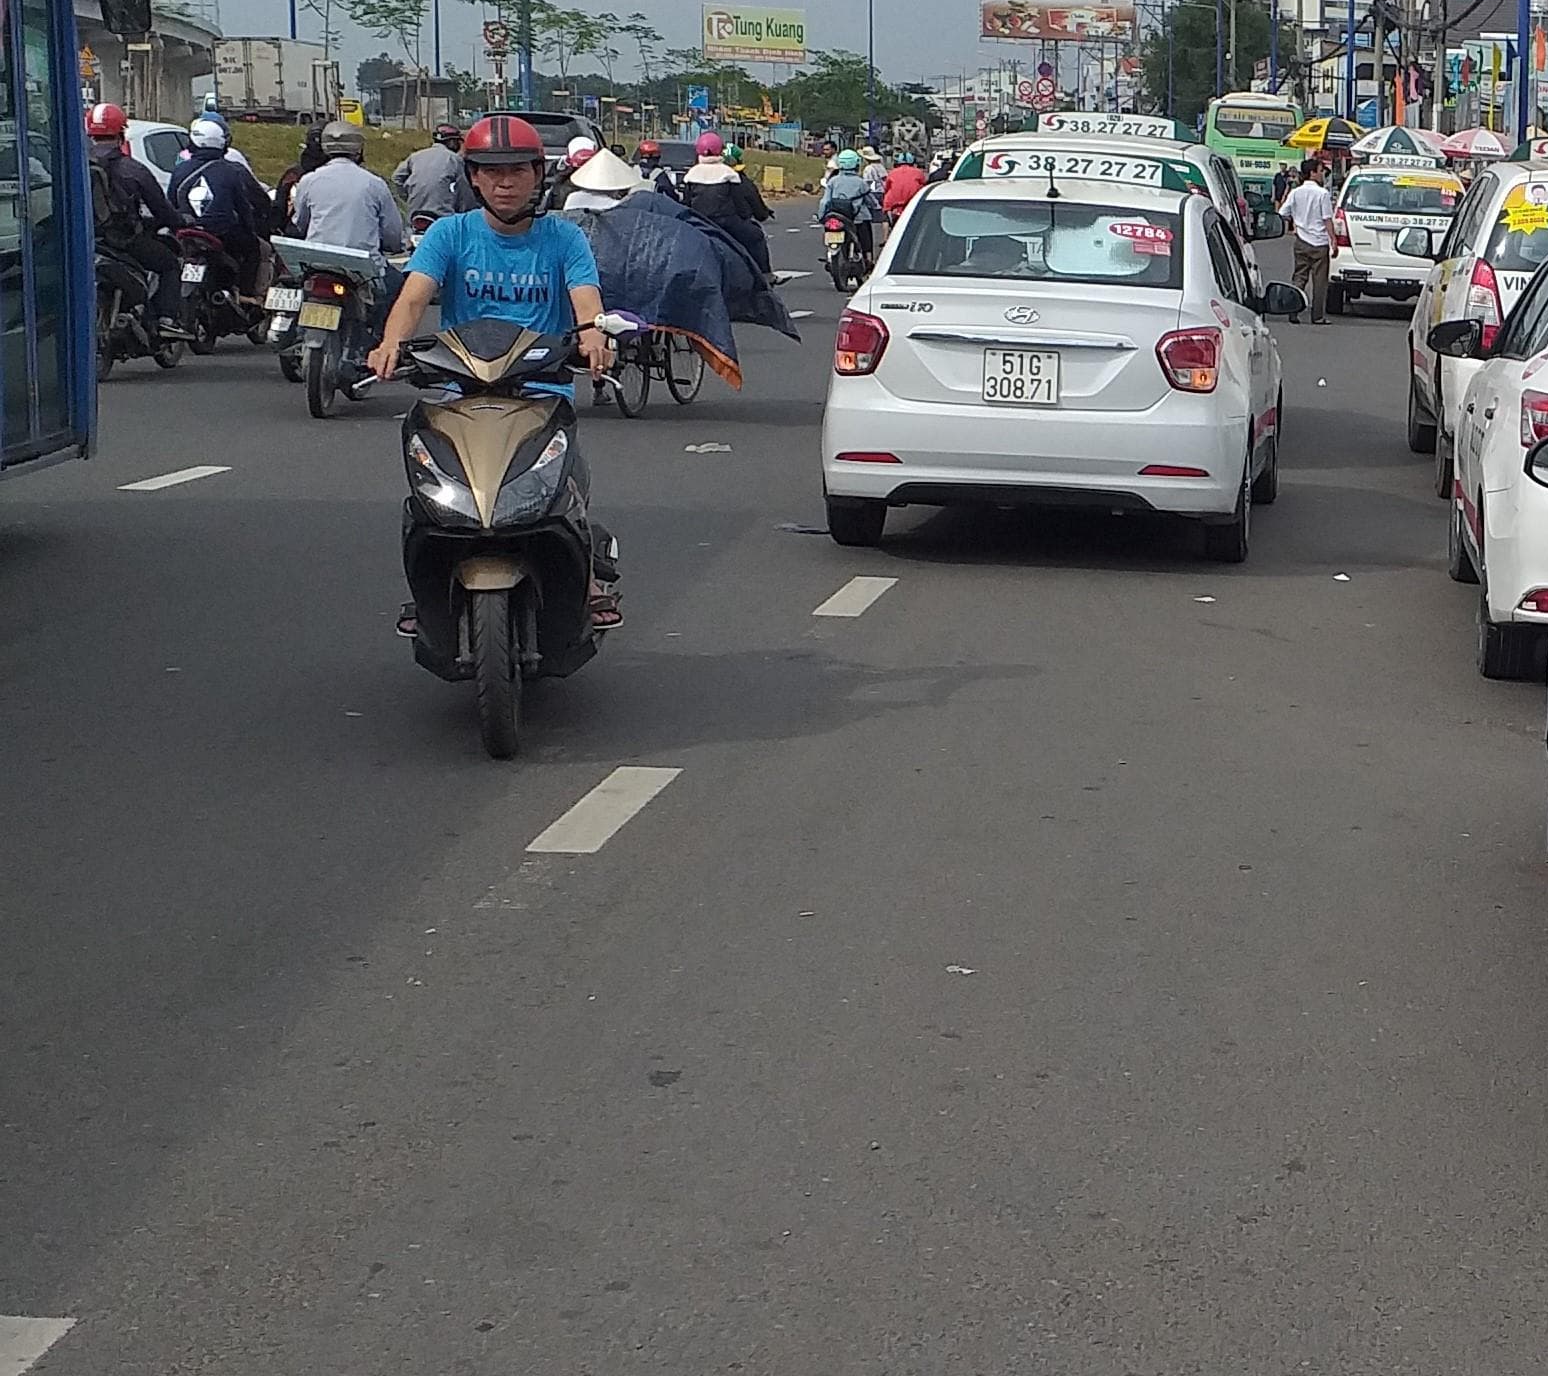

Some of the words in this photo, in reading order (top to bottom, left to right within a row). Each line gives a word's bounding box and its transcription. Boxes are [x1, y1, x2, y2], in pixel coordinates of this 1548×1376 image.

[733, 15, 762, 41] Tung
[766, 17, 804, 44] Kuang
[1070, 120, 1119, 135] 38.27
[1122, 123, 1143, 135] 27
[1147, 125, 1168, 137] 27
[1028, 155, 1093, 175] 38.27
[1100, 160, 1127, 178] 27
[1133, 164, 1161, 180] 27
[1114, 224, 1167, 240] 12784
[464, 267, 549, 304] CALVIN
[1001, 350, 1042, 376] 51G
[985, 375, 1054, 402] 308.71
